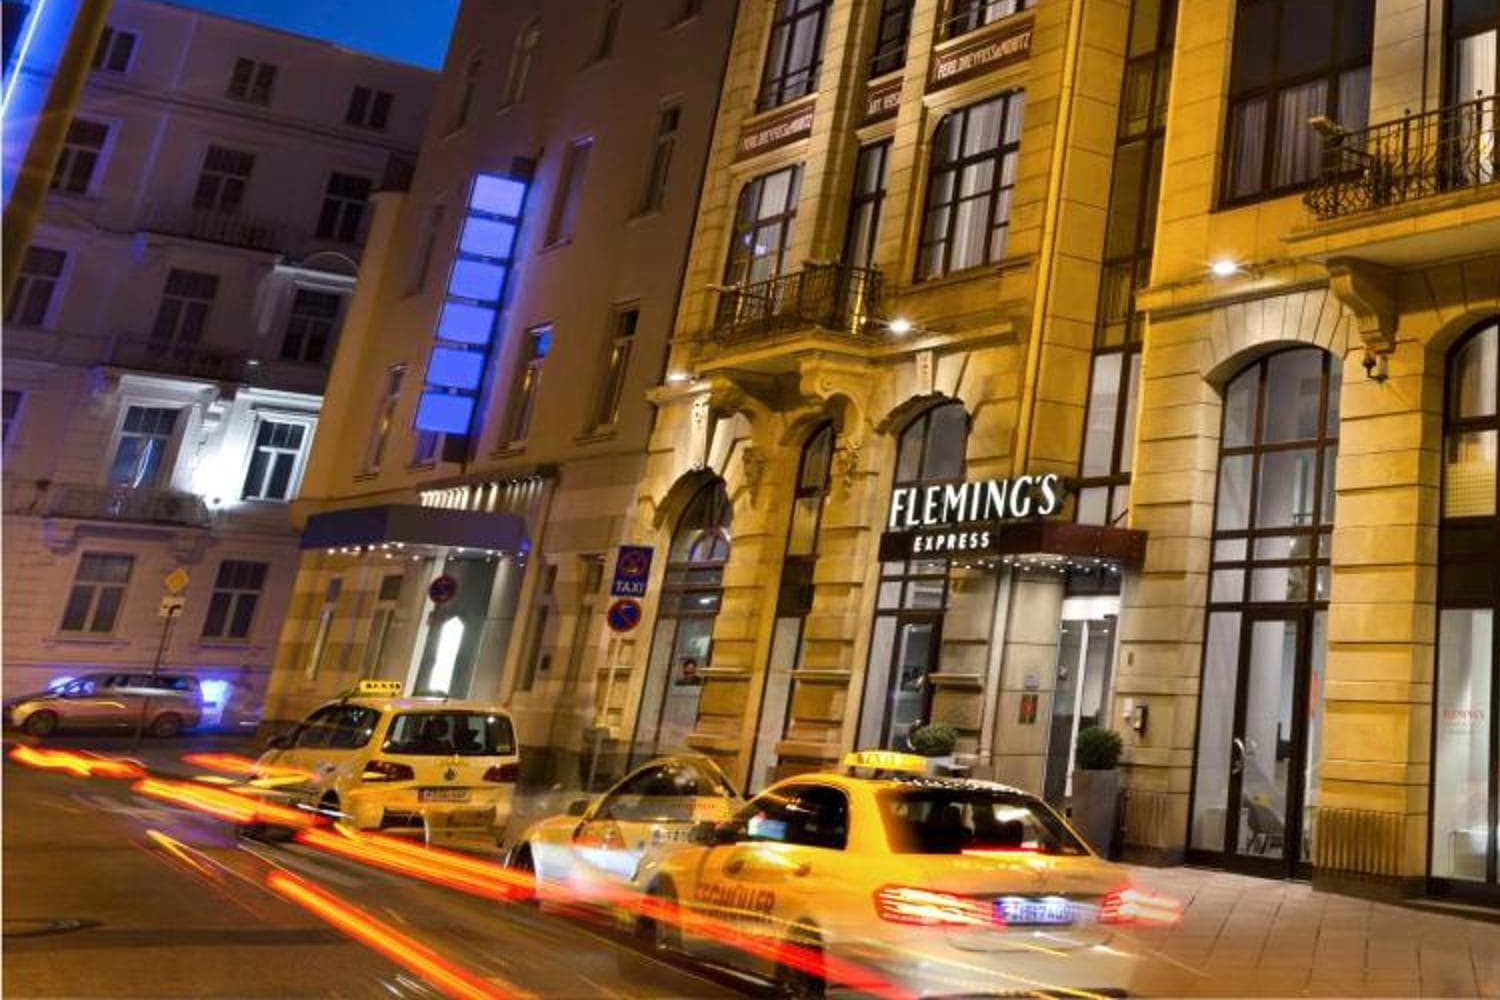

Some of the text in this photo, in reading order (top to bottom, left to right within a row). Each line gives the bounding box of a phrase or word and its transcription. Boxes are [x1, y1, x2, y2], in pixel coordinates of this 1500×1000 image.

[889, 473, 1058, 527] FLEMING'S
[913, 531, 990, 553] EXPRESS
[615, 580, 644, 593] TAXI
